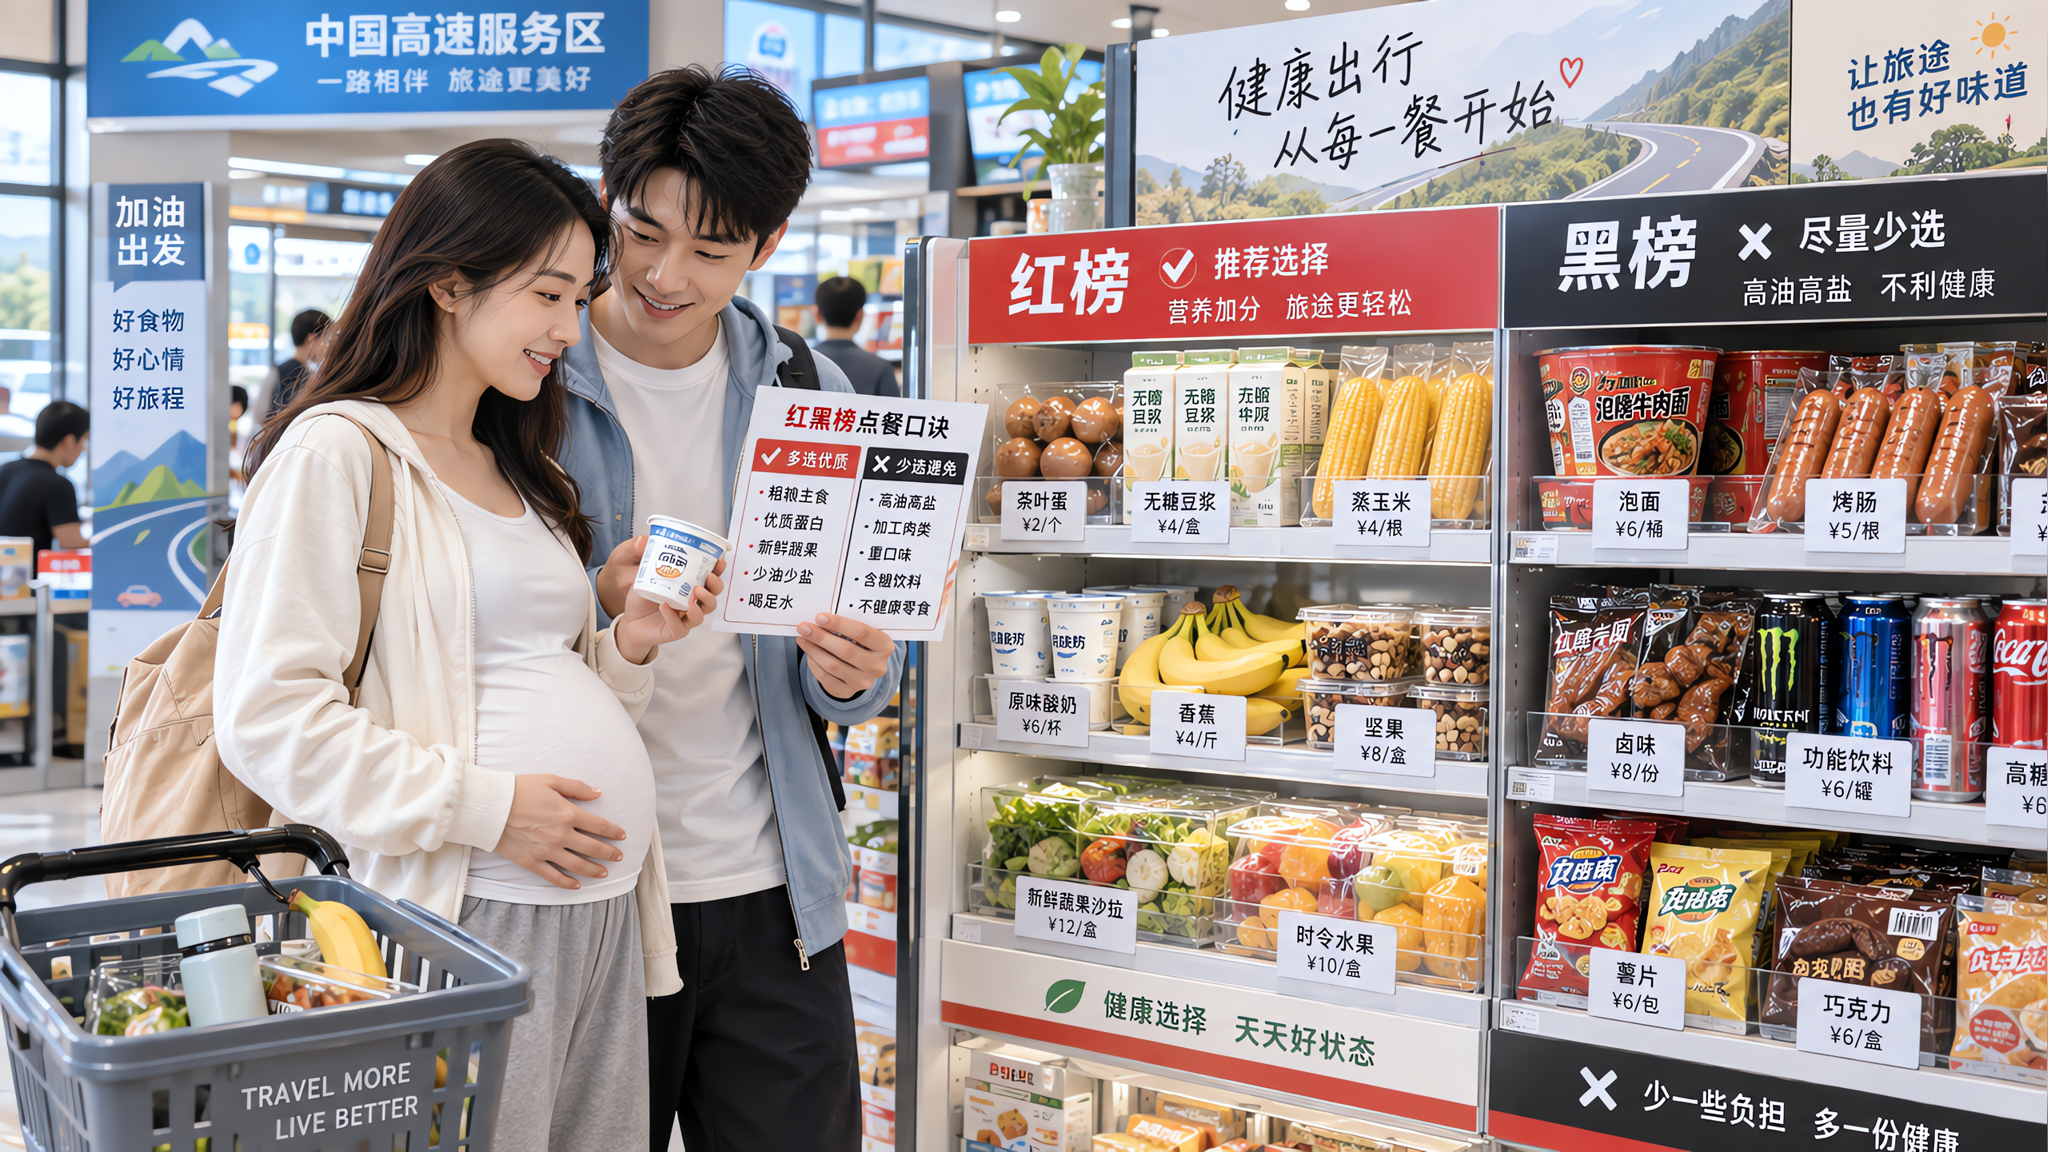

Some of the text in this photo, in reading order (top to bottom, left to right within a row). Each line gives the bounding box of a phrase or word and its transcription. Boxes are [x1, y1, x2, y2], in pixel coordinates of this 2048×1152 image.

[306, 11, 605, 58] 中国高速服务区
[1218, 32, 1423, 121] 健康出行
[1848, 39, 1950, 91] 让旅途
[317, 66, 591, 94] 一路相伴 旅途更美好
[1847, 61, 2028, 132] 也有好味道
[1273, 80, 1555, 170] 从每一餐开始
[116, 195, 184, 228] 加油
[118, 234, 185, 266] 出发
[1558, 209, 1945, 292] 黑榜 尽量少选
[1009, 242, 1328, 315] 红榜 推荐选择
[1744, 268, 1995, 306] 高油高盐 不利健康
[1169, 289, 1411, 324] 营养加分 旅途更轻松
[113, 309, 184, 332] 好食物
[113, 347, 185, 371] 好心情
[113, 386, 184, 410] 好旅程
[785, 404, 949, 439] 红黑榜点餐口诀
[1017, 491, 1067, 510] 茶叶蛋
[1144, 491, 1215, 511] 无糖豆浆
[1620, 491, 1660, 512] 泡面
[1833, 491, 1876, 513] 烤肠
[873, 519, 931, 537] 加工肉类
[1023, 517, 1061, 533] ¥2/个
[1158, 518, 1200, 534] ¥4/盒
[1358, 519, 1402, 537] ¥4/根
[1616, 520, 1662, 538] ¥6/桶
[1829, 521, 1879, 540] ¥5/根
[868, 546, 911, 562] 重口味
[753, 566, 813, 584] 少油少盐
[1009, 692, 1076, 714] 原味酸奶
[1179, 704, 1215, 724] 香蕉
[1022, 719, 1061, 736] ¥6/杯
[1365, 717, 1403, 739] 坚果
[1176, 731, 1217, 749] ¥4/斤
[1616, 732, 1655, 756] 卤味
[1361, 746, 1406, 764] ¥8/盒
[1803, 746, 1893, 775] 功能饮料
[1611, 763, 1659, 782] ¥8/份
[1048, 916, 1098, 939] ¥12/盒
[1296, 925, 1375, 955] 时令水果
[1307, 954, 1361, 979] ¥10/盒
[1617, 962, 1657, 987] 薯片
[1612, 992, 1659, 1014] ¥6/包
[1823, 995, 1890, 1024] 巧克力
[1103, 990, 1376, 1067] 健康选择 天天好状态
[1831, 1026, 1882, 1051] ¥6/盒
[241, 1062, 411, 1110] TRAVEL MORE
[276, 1095, 418, 1140] LIVE BETTER
[1643, 1079, 1961, 1152] 少一些负担 多一份健康
